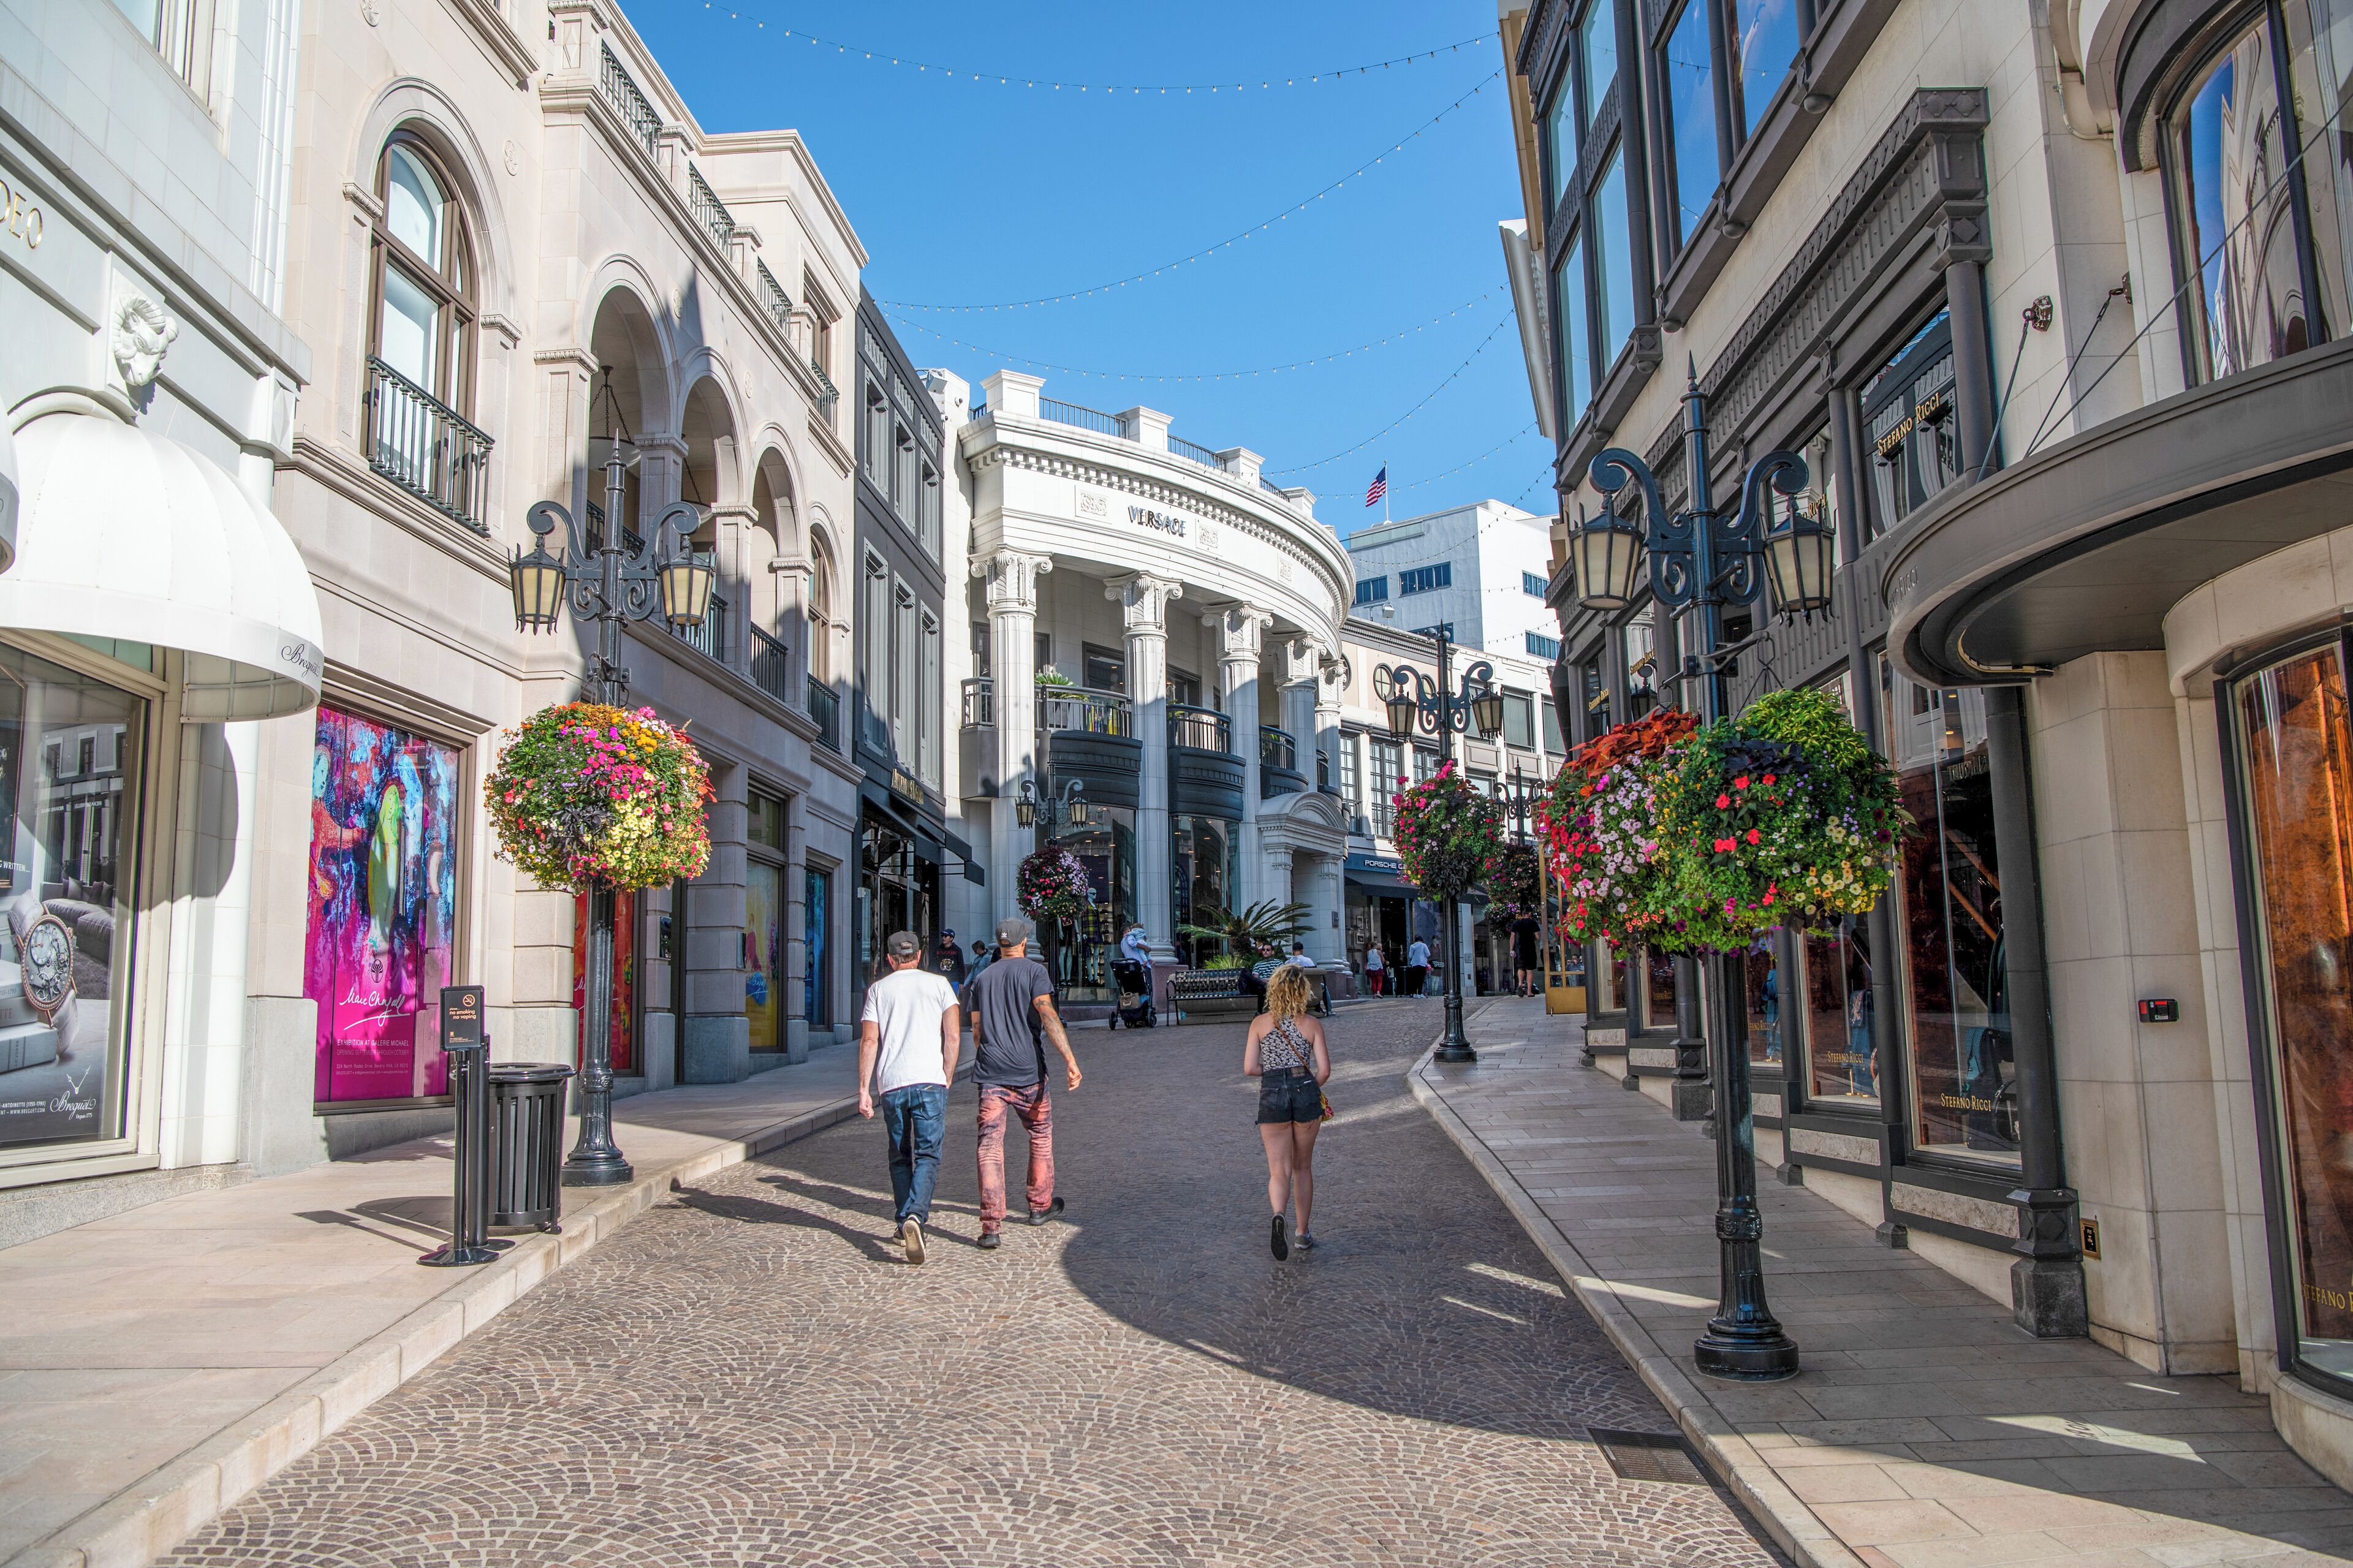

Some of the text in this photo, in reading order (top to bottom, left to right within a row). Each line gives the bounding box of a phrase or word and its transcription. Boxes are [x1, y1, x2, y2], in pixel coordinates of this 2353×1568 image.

[1877, 392, 1941, 456] STEFANO RICCI
[1128, 499, 1186, 537] VERSACE
[281, 643, 320, 678] Breguet
[3, 861, 30, 873] WRITTEN...
[1365, 860, 1396, 869] PORSCHE
[1828, 1051, 1863, 1064] STEFANO RICCI
[50, 1091, 96, 1120] Breguet
[1941, 1093, 1991, 1112] STEFANO RICCI
[2302, 1278, 2346, 1309] STEFANO
